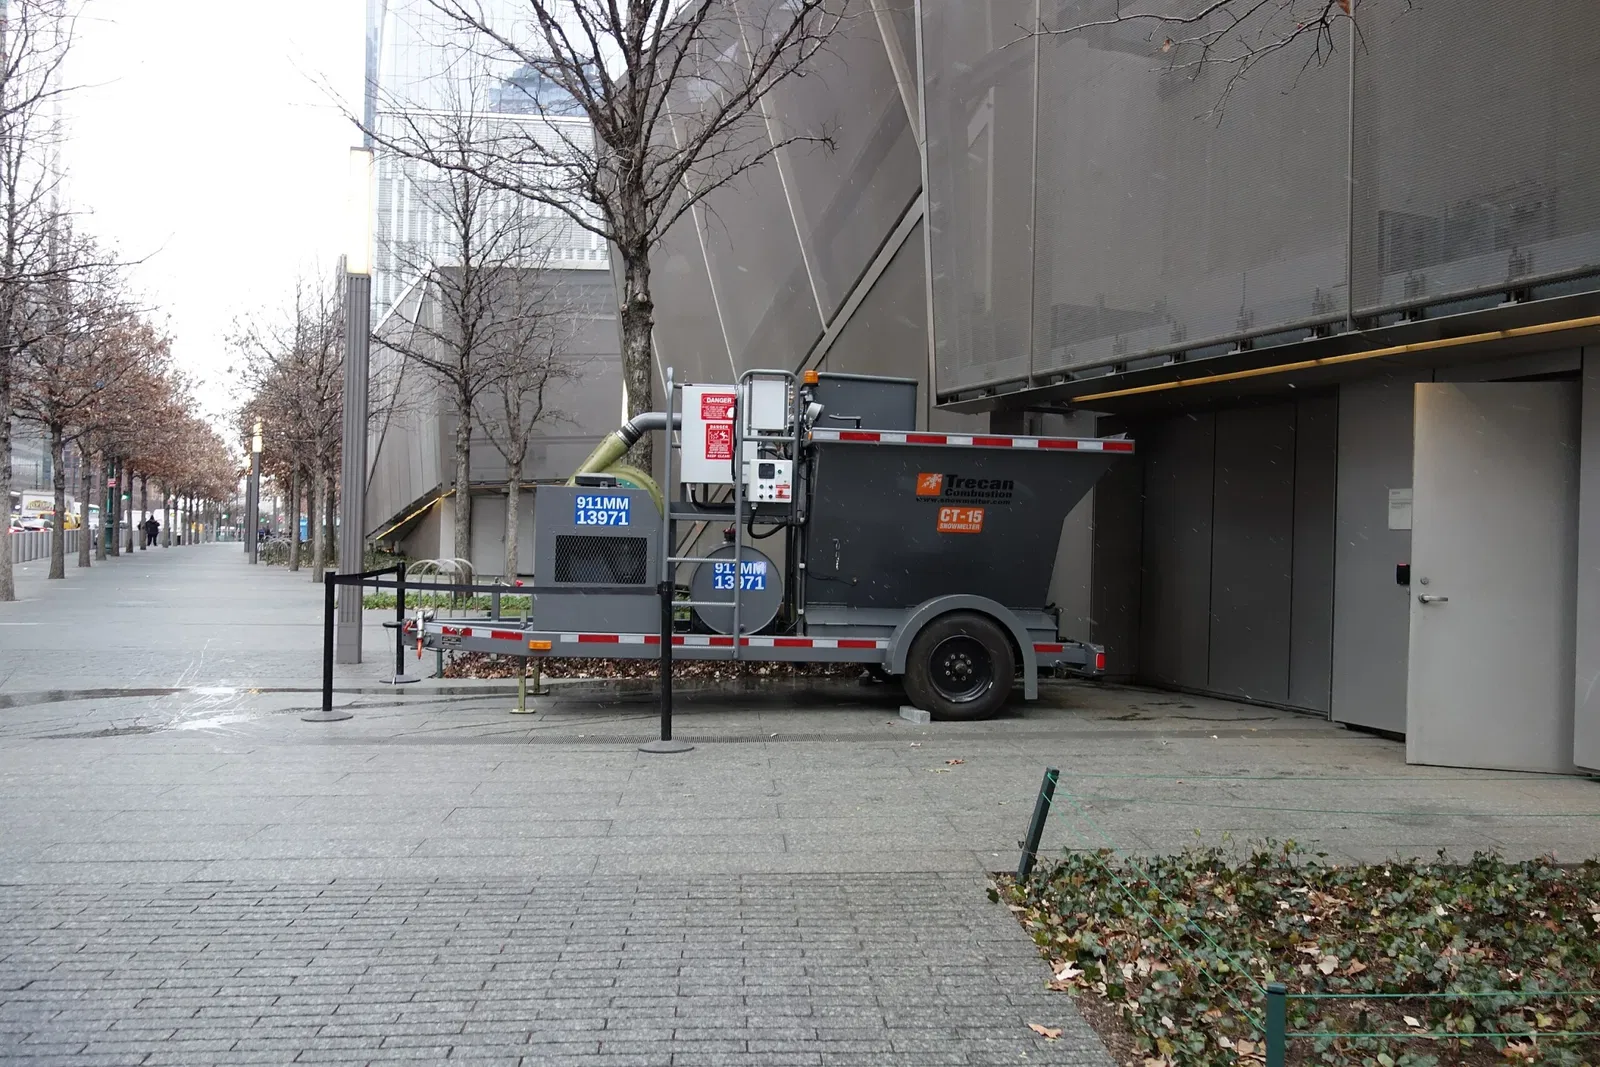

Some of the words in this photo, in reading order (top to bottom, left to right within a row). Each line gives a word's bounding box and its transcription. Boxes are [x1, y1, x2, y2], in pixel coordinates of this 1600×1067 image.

[945, 474, 1014, 491] Trecan
[945, 488, 1012, 499] Combustion
[577, 496, 629, 510] 911MM
[577, 510, 629, 526] 13971
[940, 508, 982, 523] CT-15
